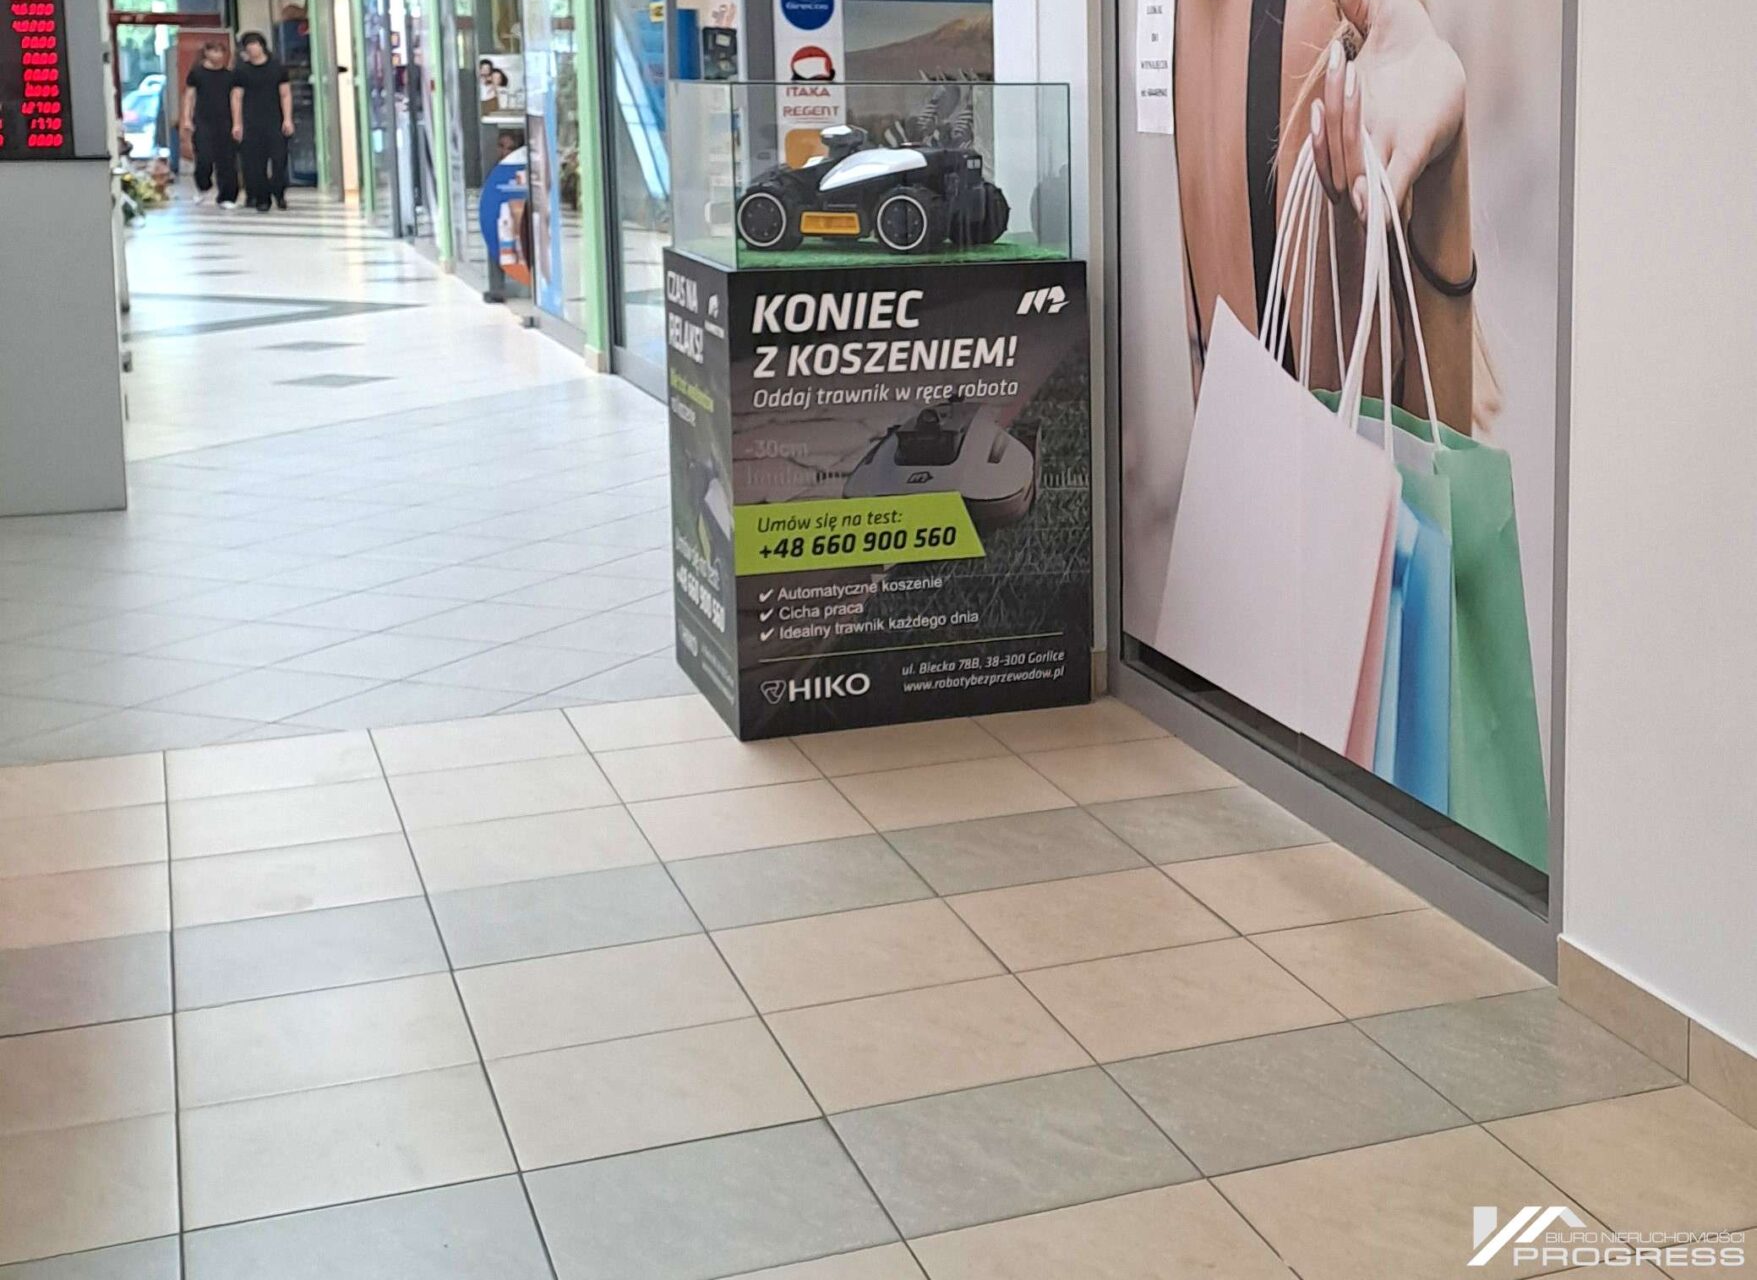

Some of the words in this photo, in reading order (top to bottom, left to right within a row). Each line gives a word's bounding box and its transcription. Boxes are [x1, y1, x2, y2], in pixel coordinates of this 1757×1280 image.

[786, 86, 831, 97] ITAKA
[752, 290, 924, 334] KONIEC
[753, 346, 779, 378] Z
[787, 335, 1018, 377] KOSZENIEM!
[753, 386, 813, 410] Oddaj
[816, 383, 890, 405] trawnik
[895, 386, 911, 401] w
[915, 384, 953, 404] ręce
[958, 379, 1018, 397] robota
[757, 515, 811, 533] Umów
[815, 513, 838, 532] się
[841, 514, 862, 526] na
[867, 509, 903, 525] test:
[759, 537, 804, 559] +48
[811, 533, 856, 556] 660
[862, 530, 907, 552] 900
[913, 526, 957, 548] 560
[777, 581, 878, 601] Automatyczne
[882, 576, 943, 592] koszenie
[779, 605, 820, 620] Cicha
[824, 602, 864, 619] praca
[780, 624, 831, 640] Idealny
[835, 619, 884, 634] trawnik
[888, 613, 946, 630] każdego
[950, 610, 979, 624] dnia
[902, 664, 916, 676] ul.
[985, 654, 1026, 668] 38-300
[1028, 650, 1065, 664] Gorlice
[789, 672, 871, 702] HIKO
[903, 665, 1065, 692] www.robotybezprzewodow.pl
